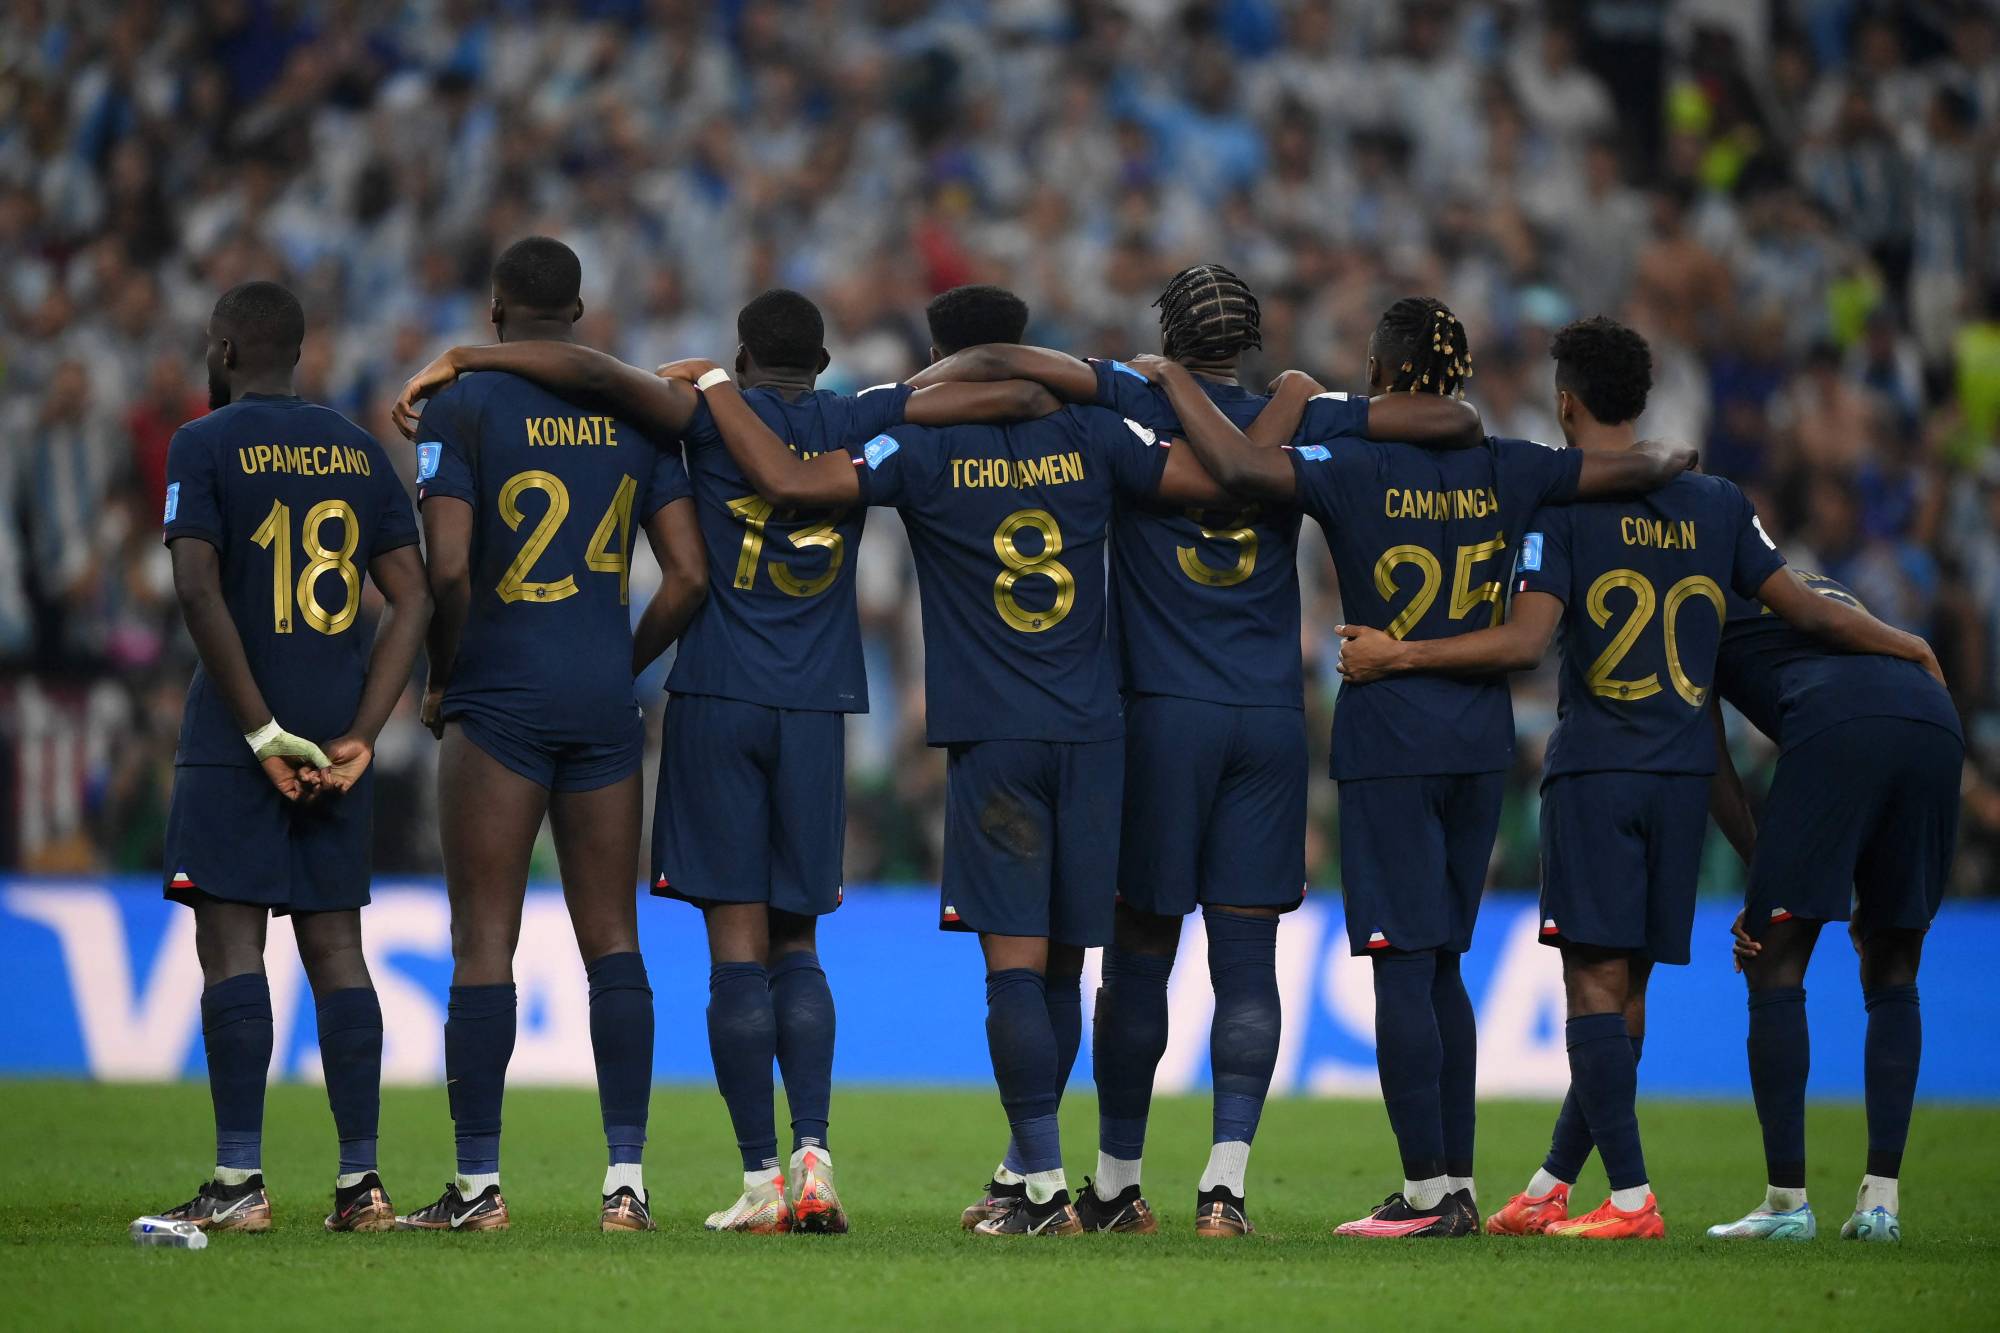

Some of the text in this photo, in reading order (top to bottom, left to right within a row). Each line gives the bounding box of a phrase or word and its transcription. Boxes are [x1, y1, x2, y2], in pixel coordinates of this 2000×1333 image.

[239, 444, 371, 477] UPAMECANO
[525, 416, 618, 447] KONATE
[950, 451, 1085, 490] TCHOUAMENI
[250, 498, 360, 636] 18
[495, 469, 638, 606] 24
[993, 508, 1076, 633] 8
[1374, 530, 1506, 641] 25
[1620, 516, 1697, 550] COMAN
[1586, 568, 1727, 707] 20
